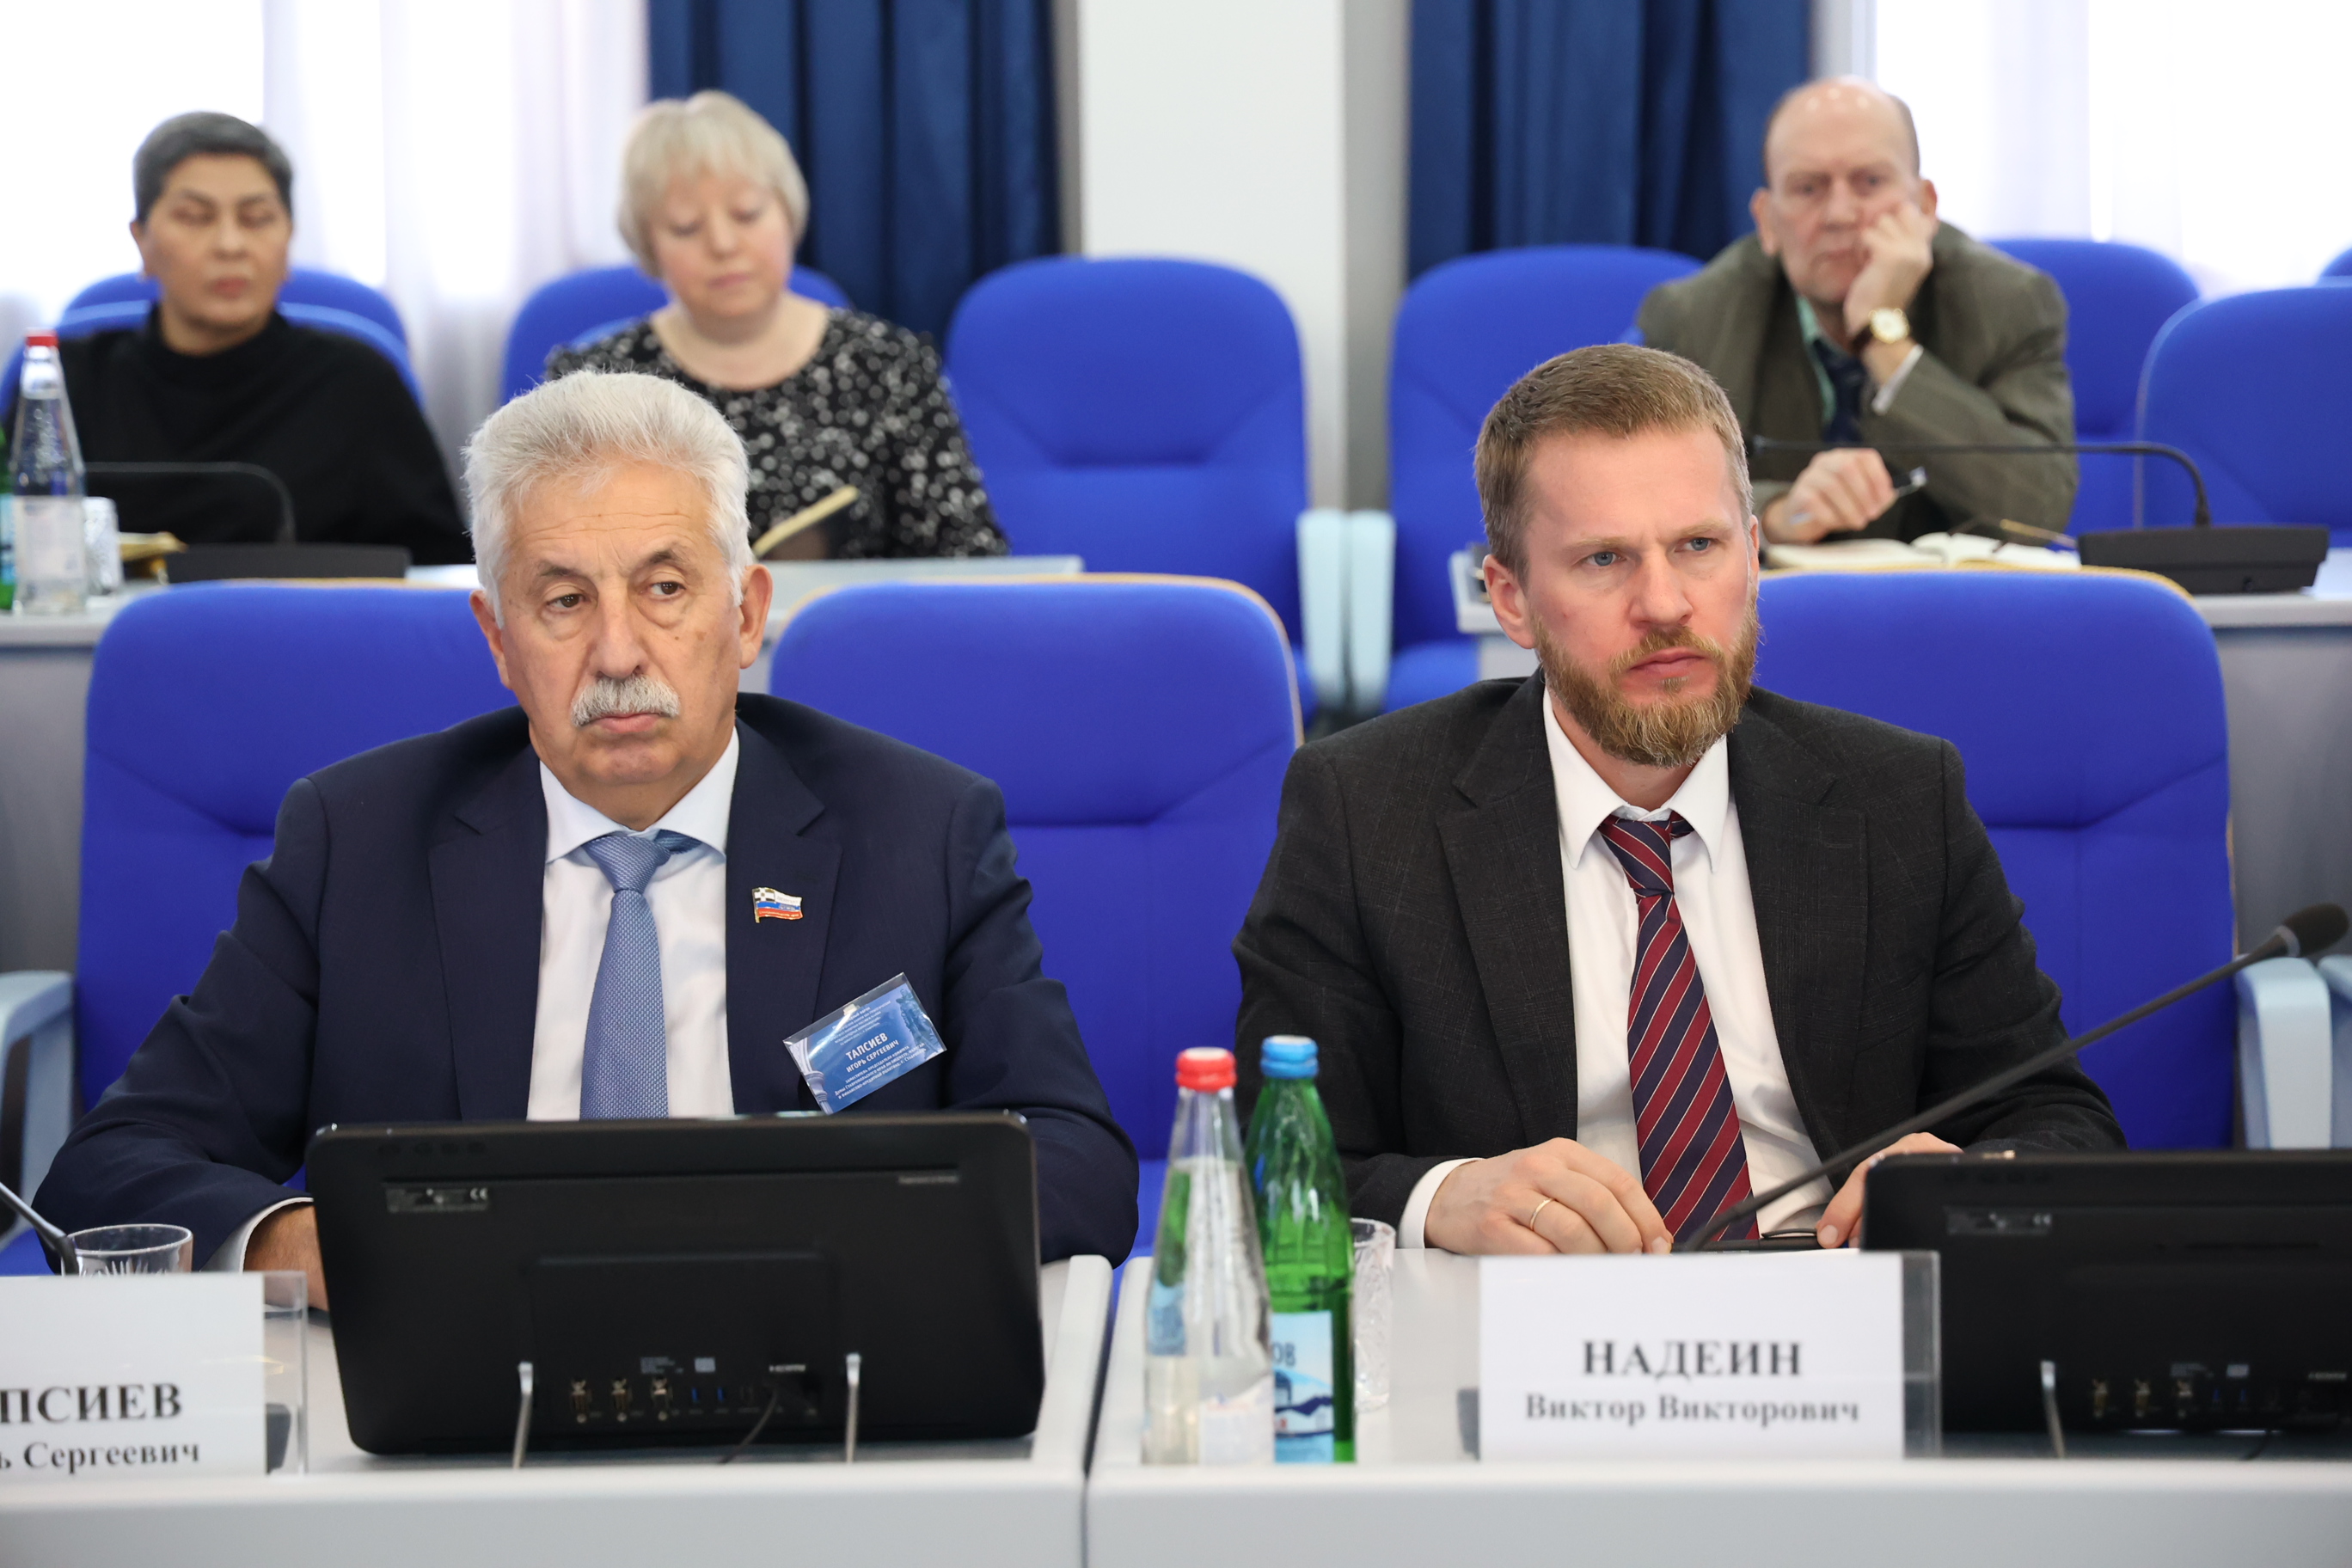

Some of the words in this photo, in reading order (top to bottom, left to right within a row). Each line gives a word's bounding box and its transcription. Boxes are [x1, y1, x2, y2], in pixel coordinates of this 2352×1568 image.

[845, 1031, 888, 1061] ТАПСИЕВ
[845, 1057, 867, 1073] ИГОРЬ
[865, 1038, 899, 1062] СЕРГЕЕВИЧ
[1584, 1341, 1799, 1379] НАДЕИН
[0, 1384, 181, 1424] ПСИЕВ
[1528, 1395, 1645, 1426] Виктор
[1660, 1396, 1858, 1427] Викторович
[23, 1443, 198, 1475] Сергеевич
